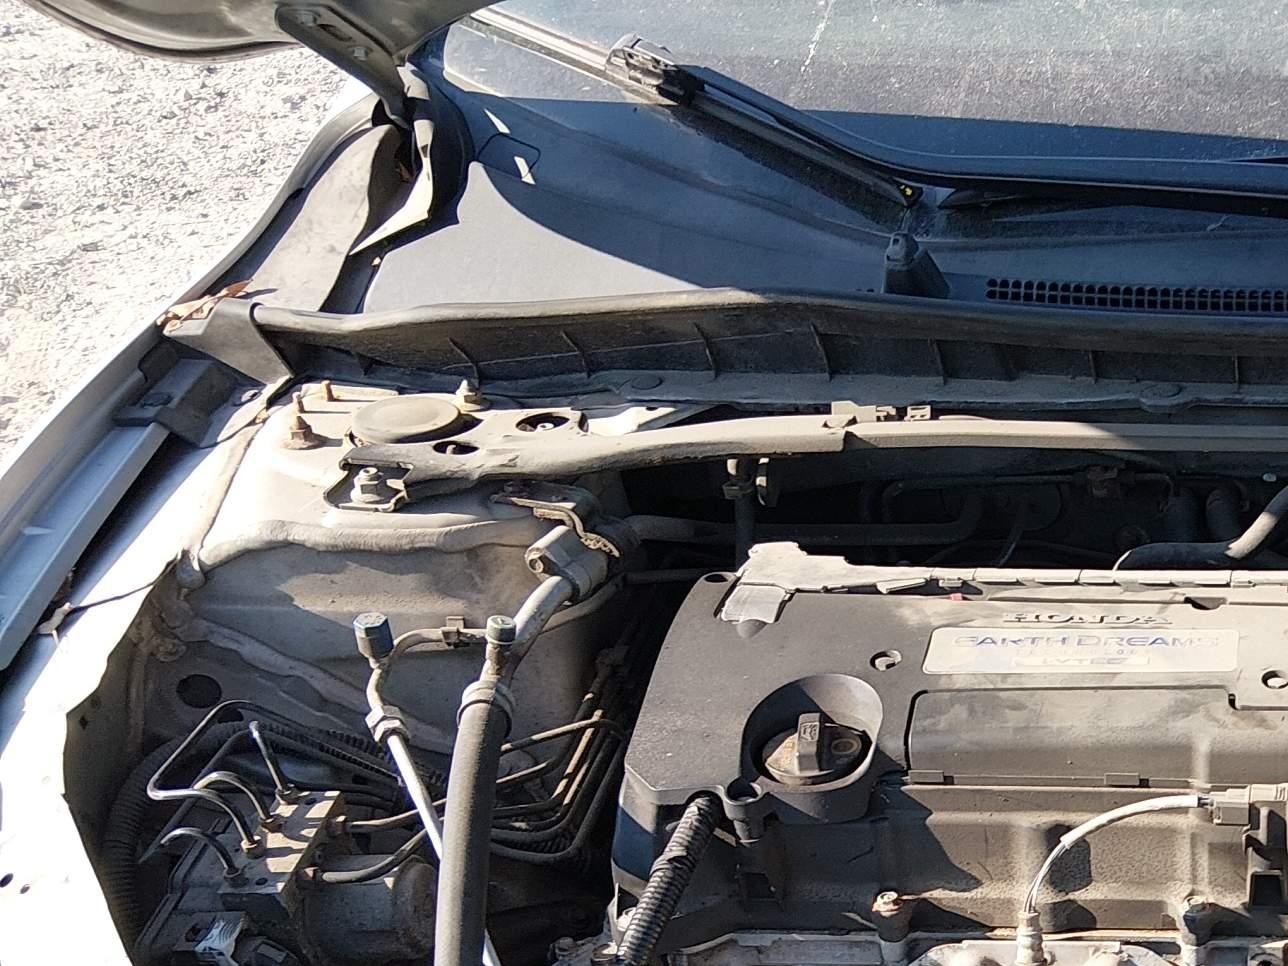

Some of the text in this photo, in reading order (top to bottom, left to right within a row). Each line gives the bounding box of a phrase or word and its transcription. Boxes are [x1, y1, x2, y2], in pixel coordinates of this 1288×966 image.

[1003, 612, 1173, 625] HONDA
[952, 634, 1221, 648] EARTH DREAMS
